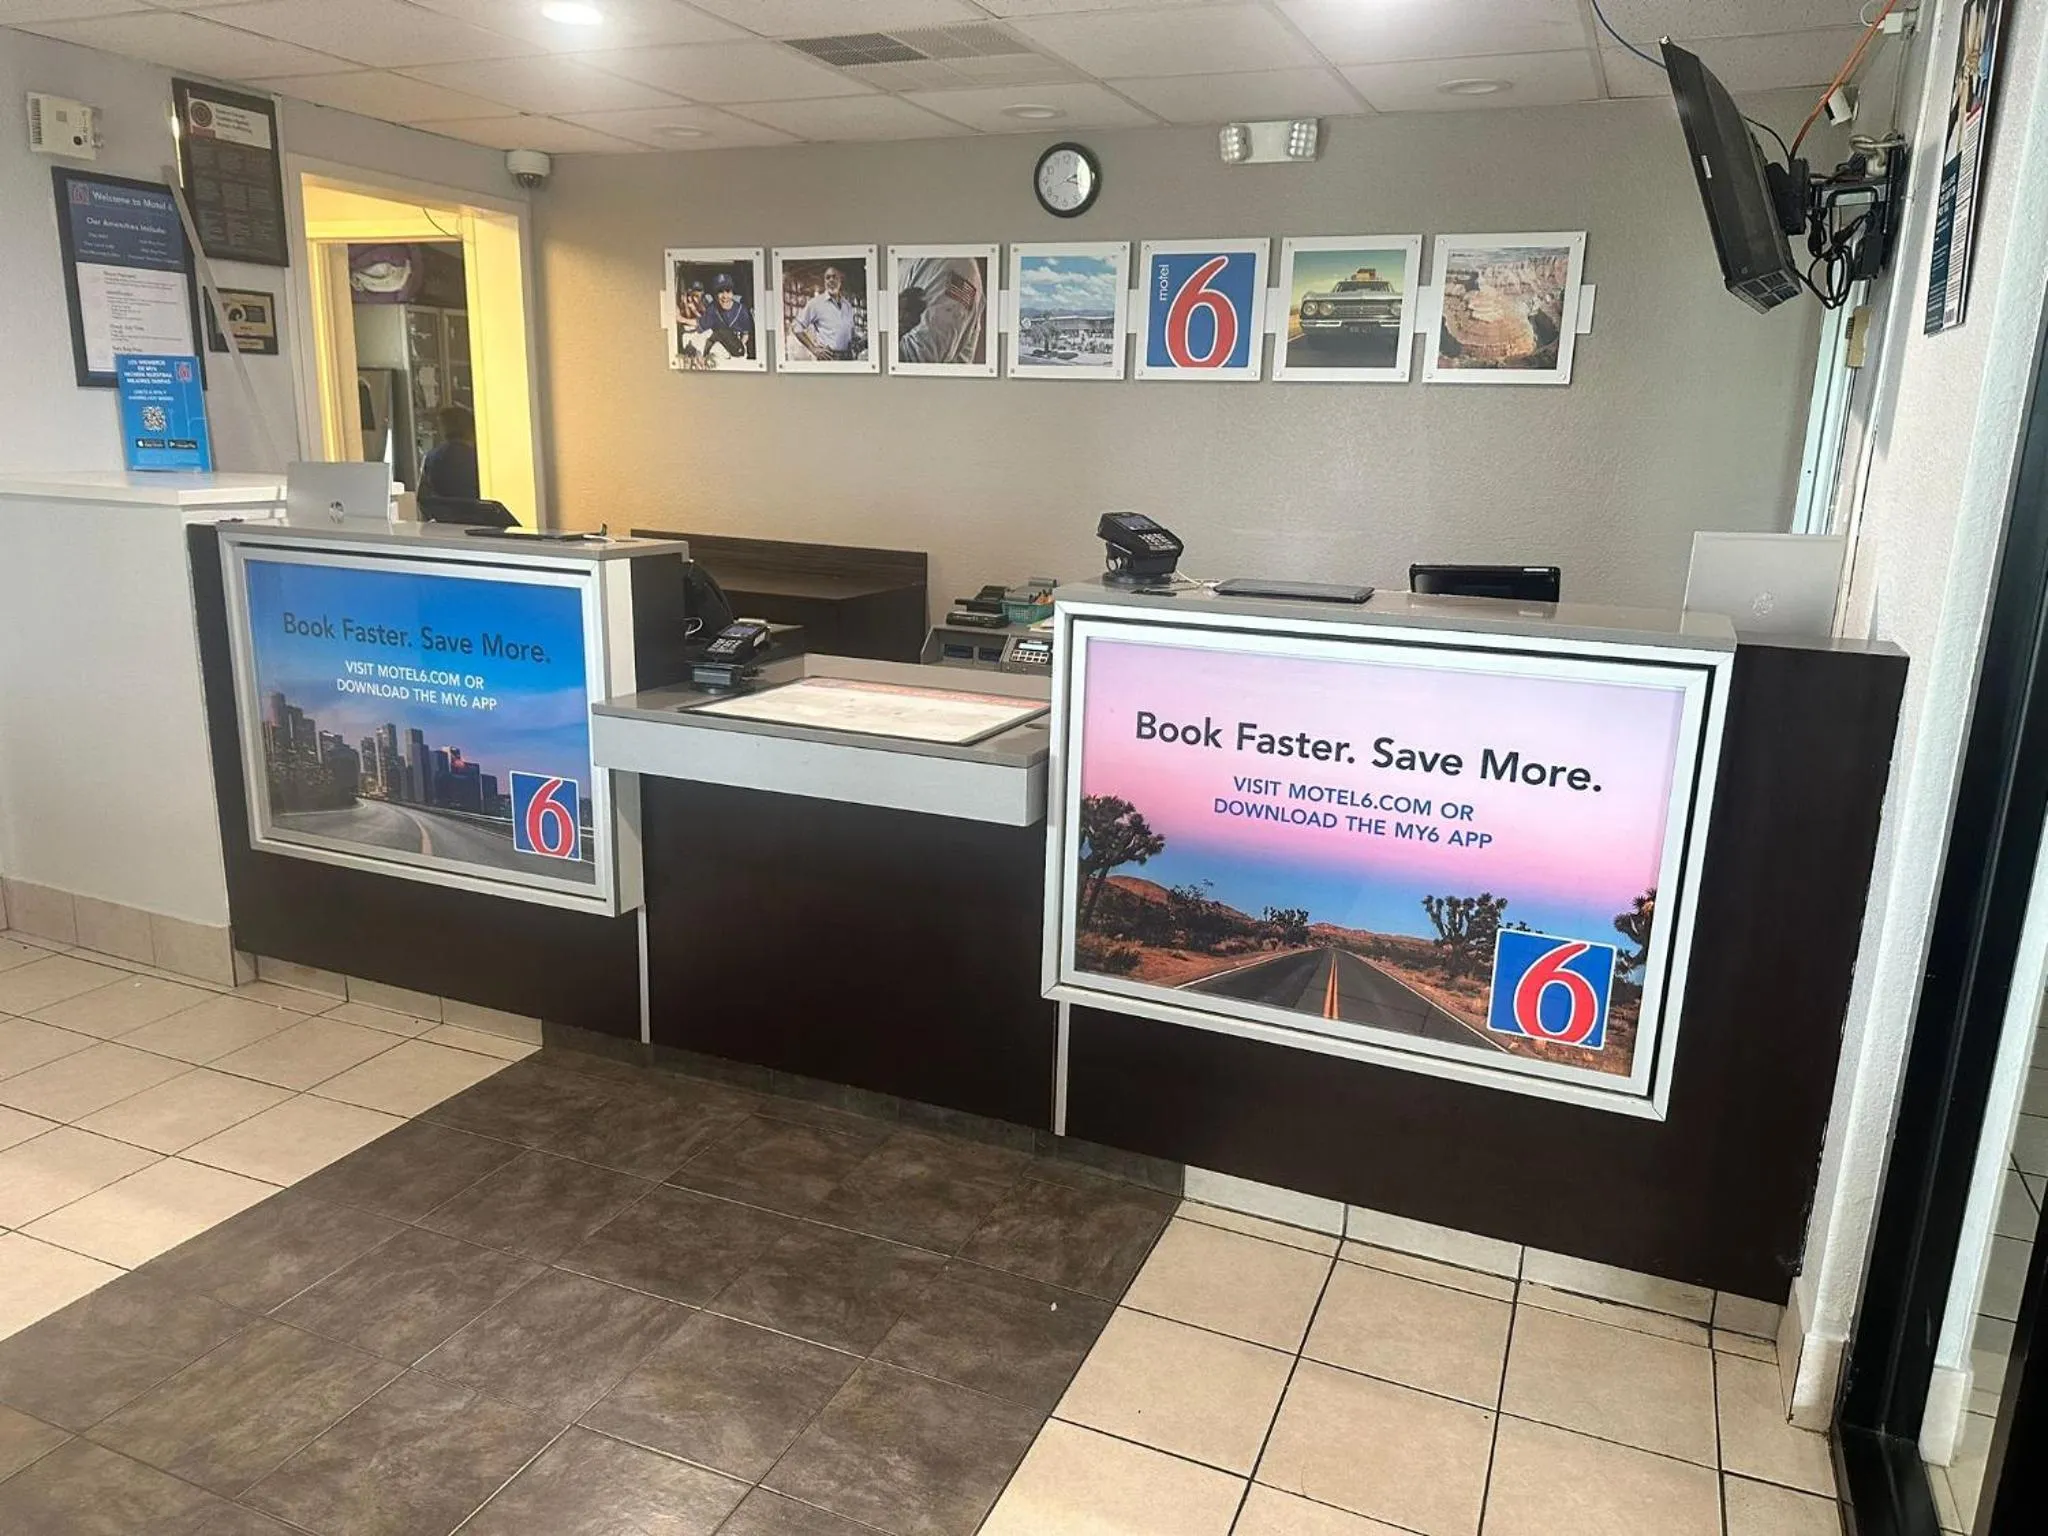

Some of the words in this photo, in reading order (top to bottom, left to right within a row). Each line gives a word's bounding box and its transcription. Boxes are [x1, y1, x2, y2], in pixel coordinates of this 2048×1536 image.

[1158, 263, 1170, 301] motel
[1165, 255, 1238, 369] 6
[283, 612, 336, 640] Book
[342, 618, 412, 648] Faster.
[420, 626, 473, 655] Save
[482, 632, 551, 663] More.
[336, 678, 409, 700] DOWNLOAD
[413, 688, 436, 704] THE
[441, 692, 468, 708] MY6
[472, 697, 497, 711] APP
[345, 660, 374, 676] VISIT
[377, 664, 460, 687] MOTEL6.COM
[464, 674, 484, 690] OR
[1136, 711, 1222, 748] Book
[1236, 722, 1355, 764] Faster.
[1371, 736, 1463, 776] Save
[1480, 748, 1602, 792] More.
[526, 777, 575, 859] 6
[1214, 798, 1338, 829] DOWNLOAD
[1345, 815, 1386, 836] THE
[1394, 821, 1440, 843] MY6
[1447, 829, 1493, 849] APP
[1233, 775, 1282, 797] VISIT
[1289, 783, 1432, 816] MOTEL6.COM
[1440, 802, 1474, 822] OR
[1513, 940, 1599, 1044] 6
